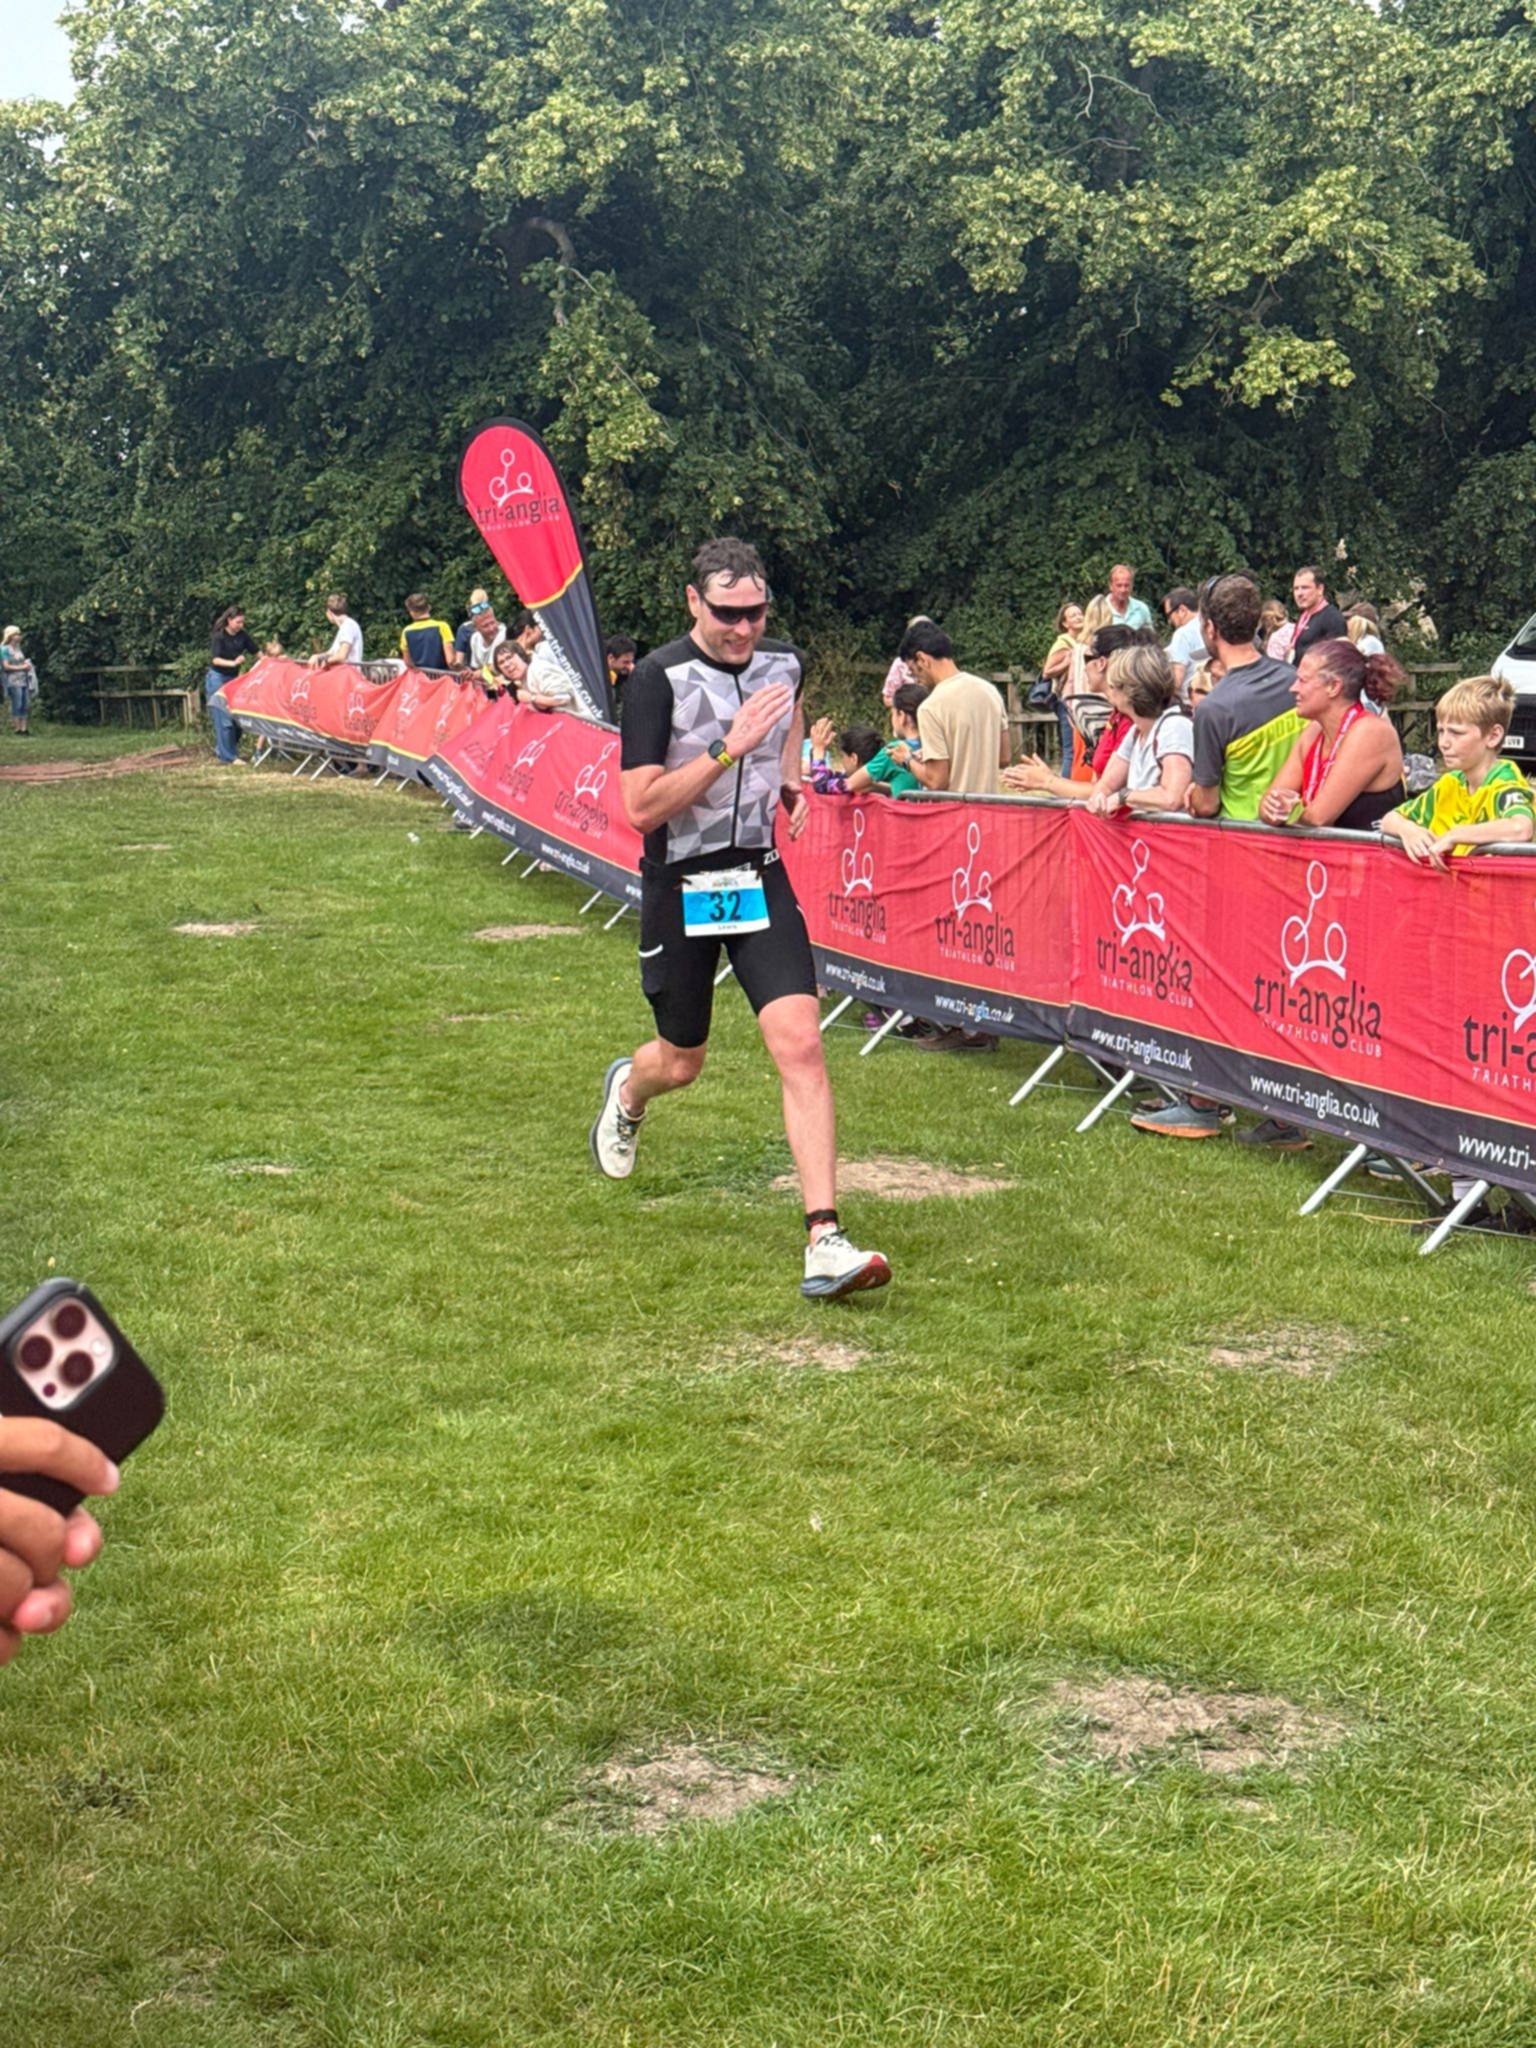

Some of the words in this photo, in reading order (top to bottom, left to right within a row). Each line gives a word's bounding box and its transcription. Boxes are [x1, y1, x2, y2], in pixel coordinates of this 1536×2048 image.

[477, 492, 560, 524] tri-anglia
[709, 890, 742, 922] 32
[828, 891, 887, 940] tri-anglia
[934, 911, 1015, 967] tri-anglia
[939, 946, 983, 965] TRIATHLON
[995, 958, 1015, 972] CLUB
[1097, 931, 1192, 1000] tri-anglia
[934, 995, 1015, 1023] www.tri-anglia.co.uk
[1168, 991, 1194, 1009] CLUB
[1253, 969, 1382, 1048] tri-anglia
[1091, 1028, 1193, 1072] www.tri-anglia.co.uk
[1350, 1038, 1382, 1058] CLUB
[1250, 1075, 1380, 1128] www.tri-anglia.co.uk
